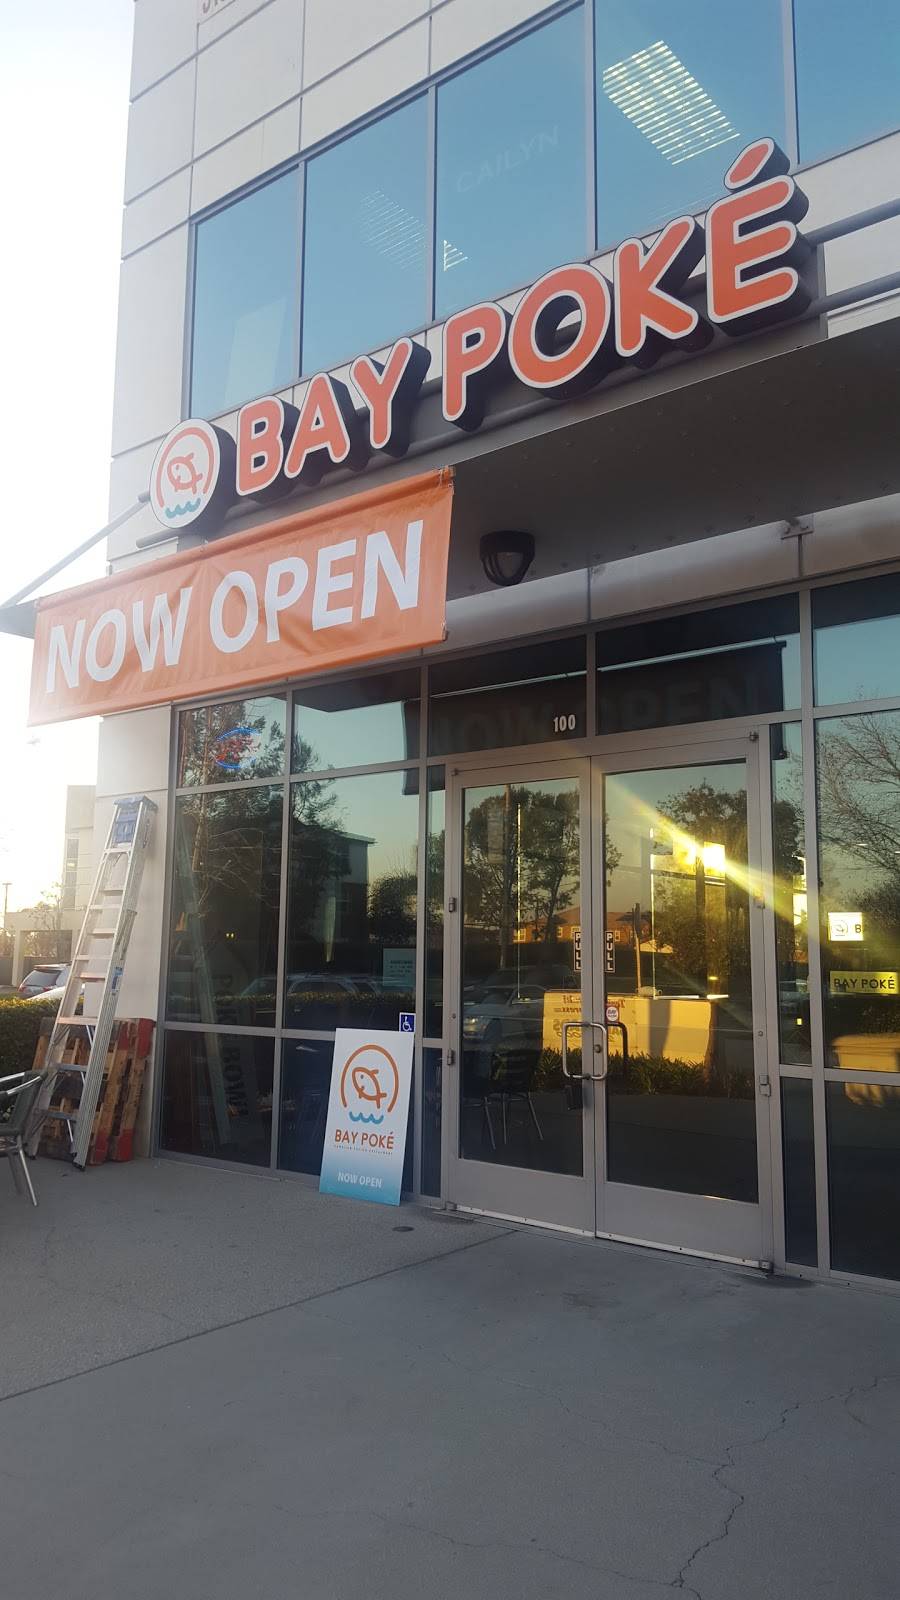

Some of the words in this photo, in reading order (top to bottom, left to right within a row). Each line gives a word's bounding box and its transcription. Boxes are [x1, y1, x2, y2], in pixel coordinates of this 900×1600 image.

[236, 337, 413, 496] BAY
[442, 137, 798, 421] POKÉ
[46, 587, 192, 693] NOW
[210, 520, 423, 653] OPEN
[554, 714, 576, 732] 100
[606, 932, 614, 971] PULL
[833, 978, 858, 989] BAY
[861, 976, 895, 989] POKÉ
[335, 1129, 358, 1144] BAY
[361, 1131, 394, 1149] POKÉ
[337, 1171, 358, 1184] NOW
[359, 1175, 383, 1188] OPEN
